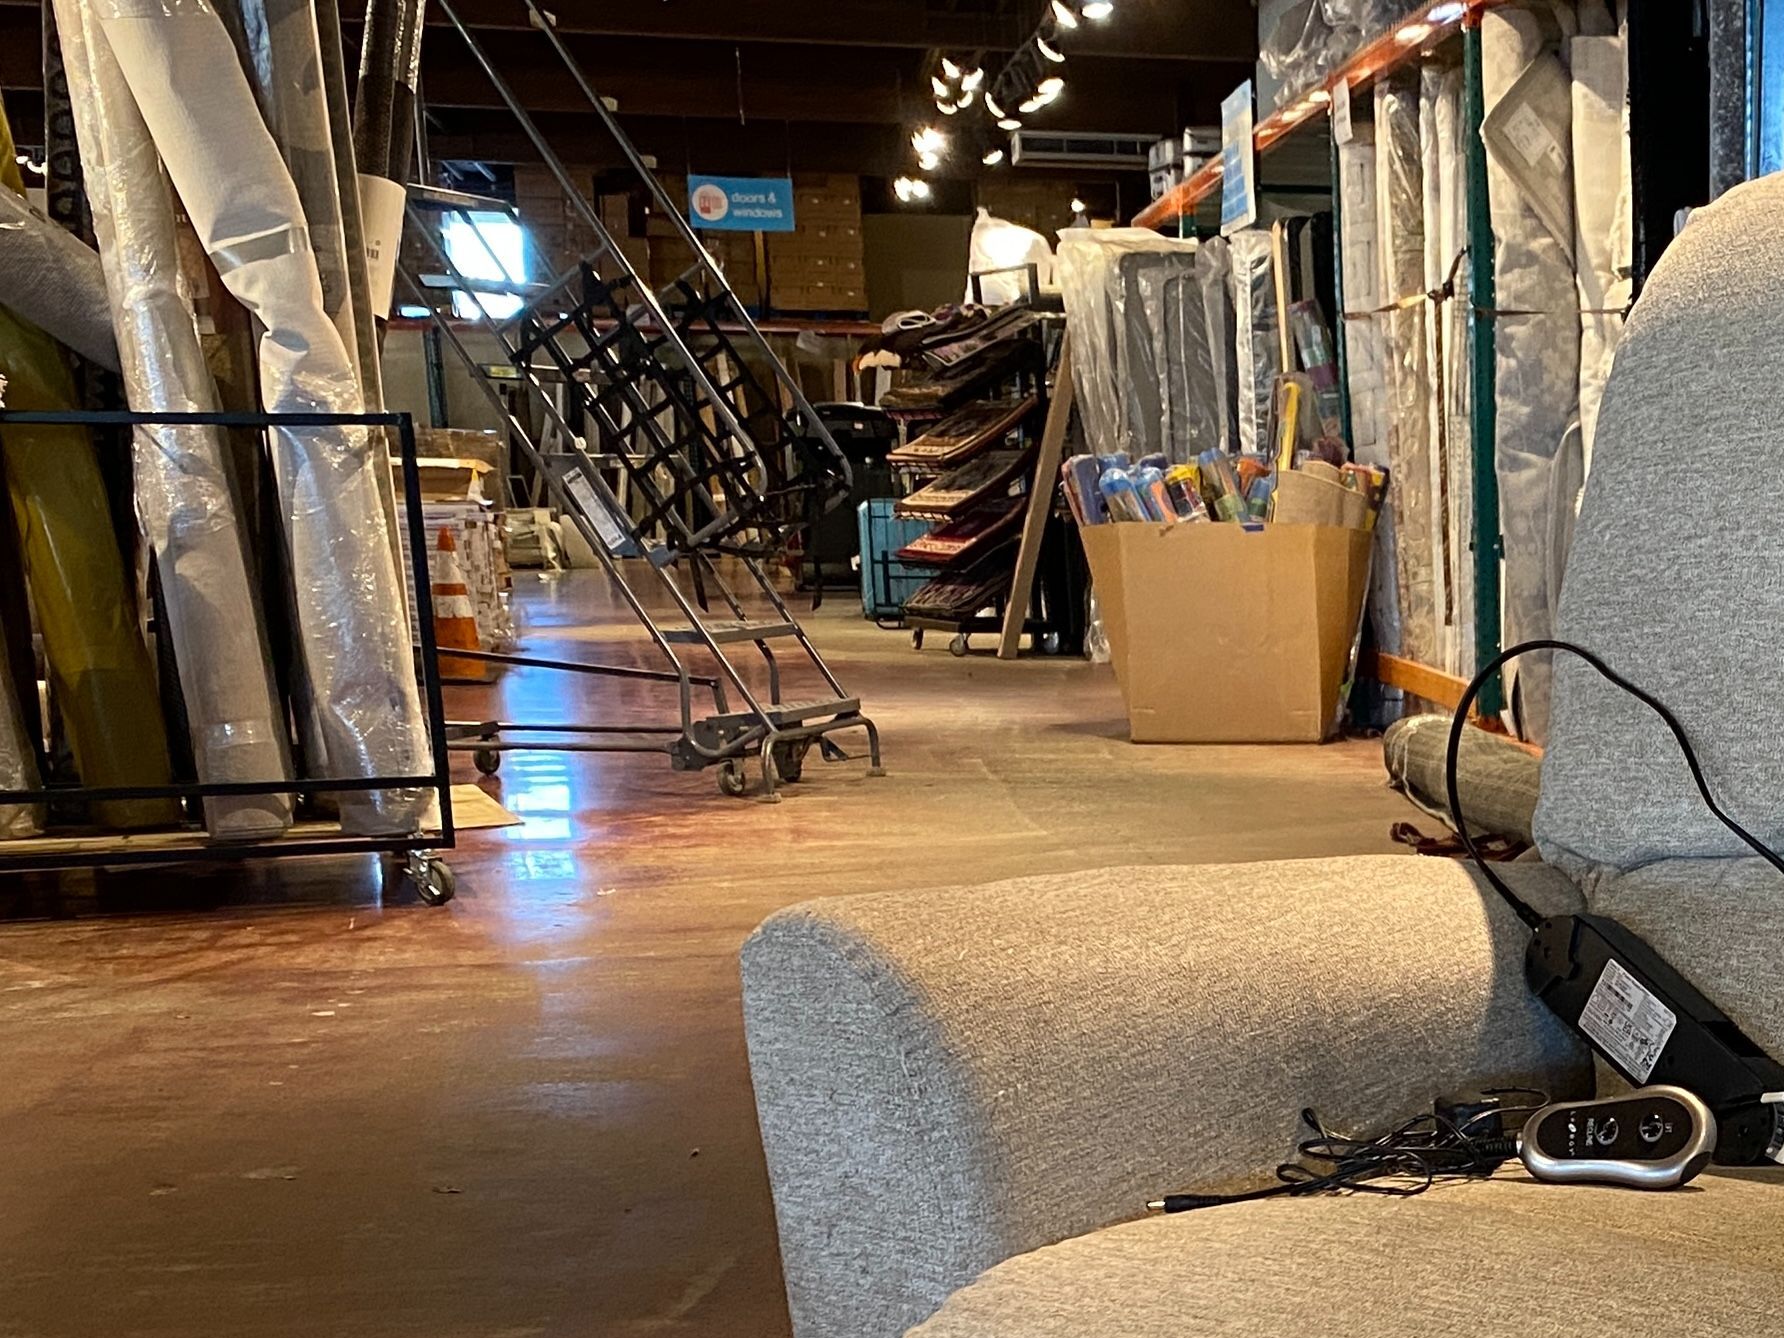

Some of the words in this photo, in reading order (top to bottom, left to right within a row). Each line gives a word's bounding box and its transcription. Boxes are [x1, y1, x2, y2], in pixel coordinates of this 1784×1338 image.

[731, 192, 766, 204] doors
[767, 191, 776, 204] &
[732, 208, 783, 219] windows
